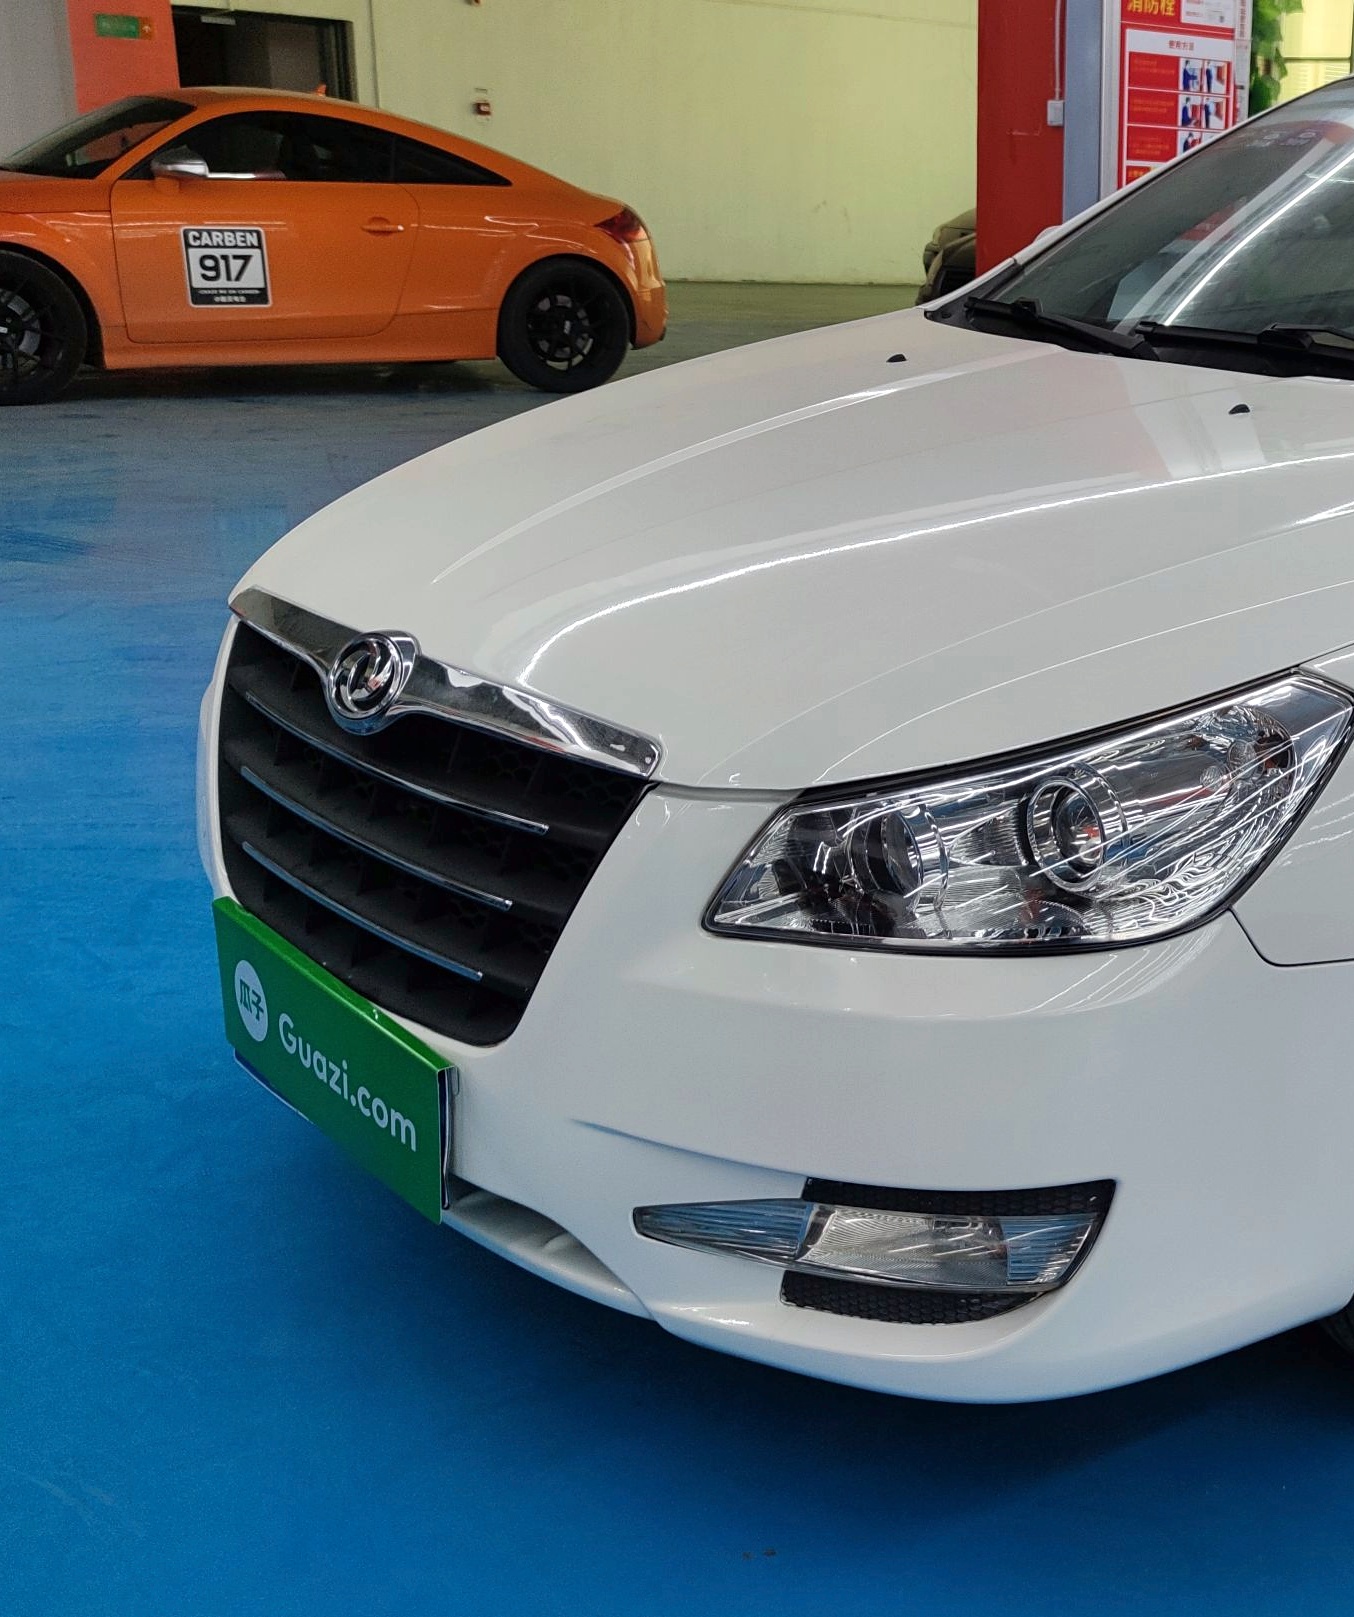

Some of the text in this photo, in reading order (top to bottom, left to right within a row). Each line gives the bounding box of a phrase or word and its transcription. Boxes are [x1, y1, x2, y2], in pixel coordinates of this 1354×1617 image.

[188, 231, 259, 247] CARBEN
[199, 254, 253, 282] 917
[239, 978, 264, 1022] 瓜子
[278, 1013, 417, 1152] Guazi.com
